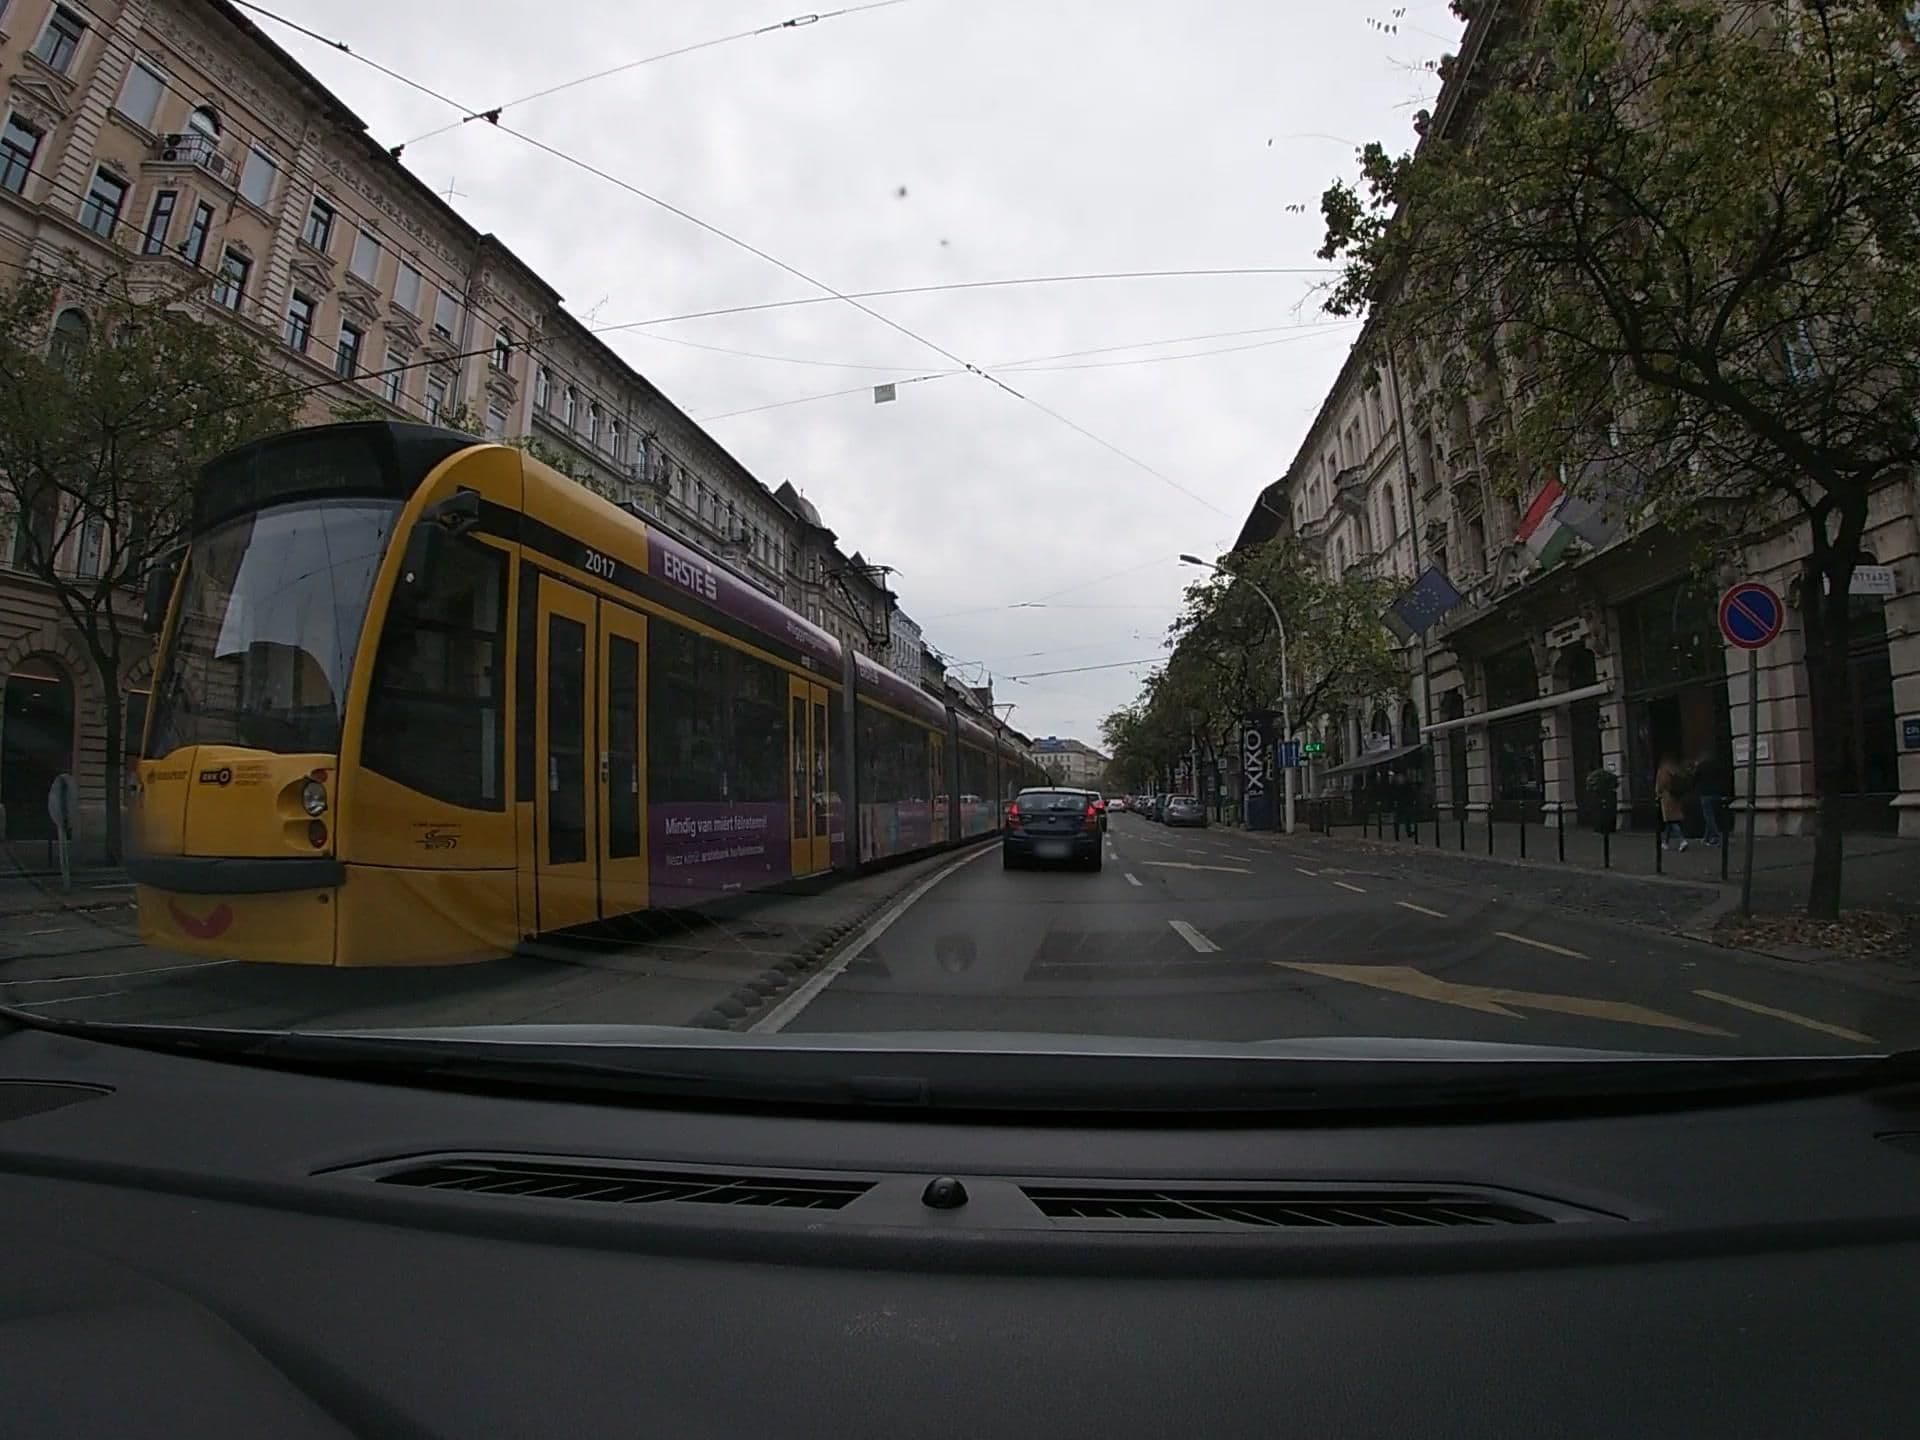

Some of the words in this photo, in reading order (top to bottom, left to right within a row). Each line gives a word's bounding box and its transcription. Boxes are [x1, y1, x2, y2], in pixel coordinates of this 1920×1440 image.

[584, 550, 616, 579] 2017
[663, 550, 704, 595] ERSTE
[665, 817, 697, 838] Mindig
[697, 819, 713, 833] van
